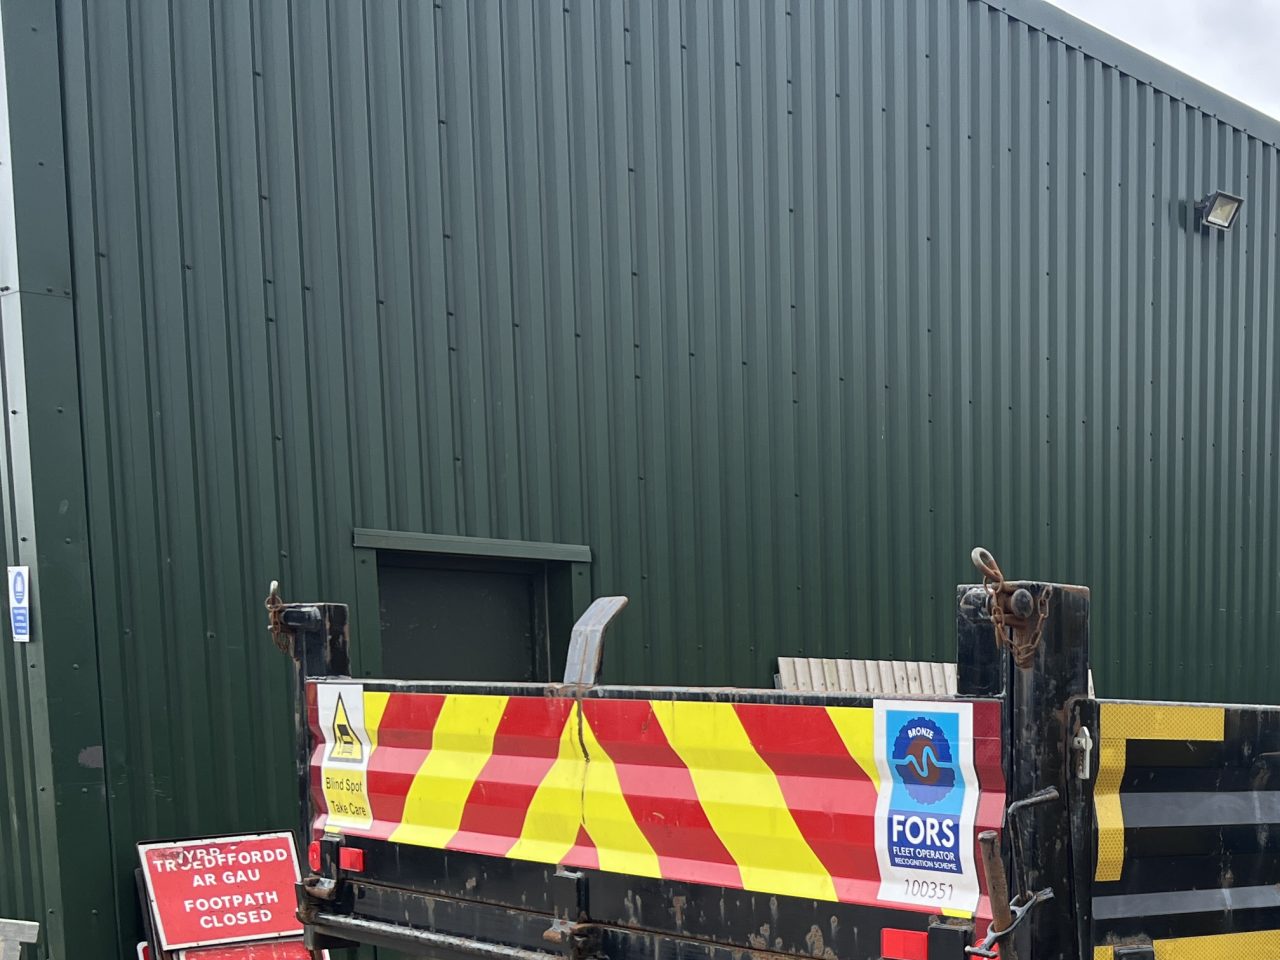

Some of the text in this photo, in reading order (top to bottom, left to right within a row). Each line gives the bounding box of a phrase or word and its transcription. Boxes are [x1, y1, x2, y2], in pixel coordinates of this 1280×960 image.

[907, 726, 935, 740] BRONZE
[326, 776, 363, 793] Blind Spot
[331, 800, 367, 816] Take Care
[892, 814, 955, 848] FORS
[892, 846, 956, 861] FLEET OPERATOR
[894, 857, 958, 871] RECOGNITION SCHEME
[192, 868, 261, 888] AR GAU
[905, 878, 953, 901] 100351
[184, 891, 279, 912] FOOTPATH
[200, 909, 272, 929] CLOSED
